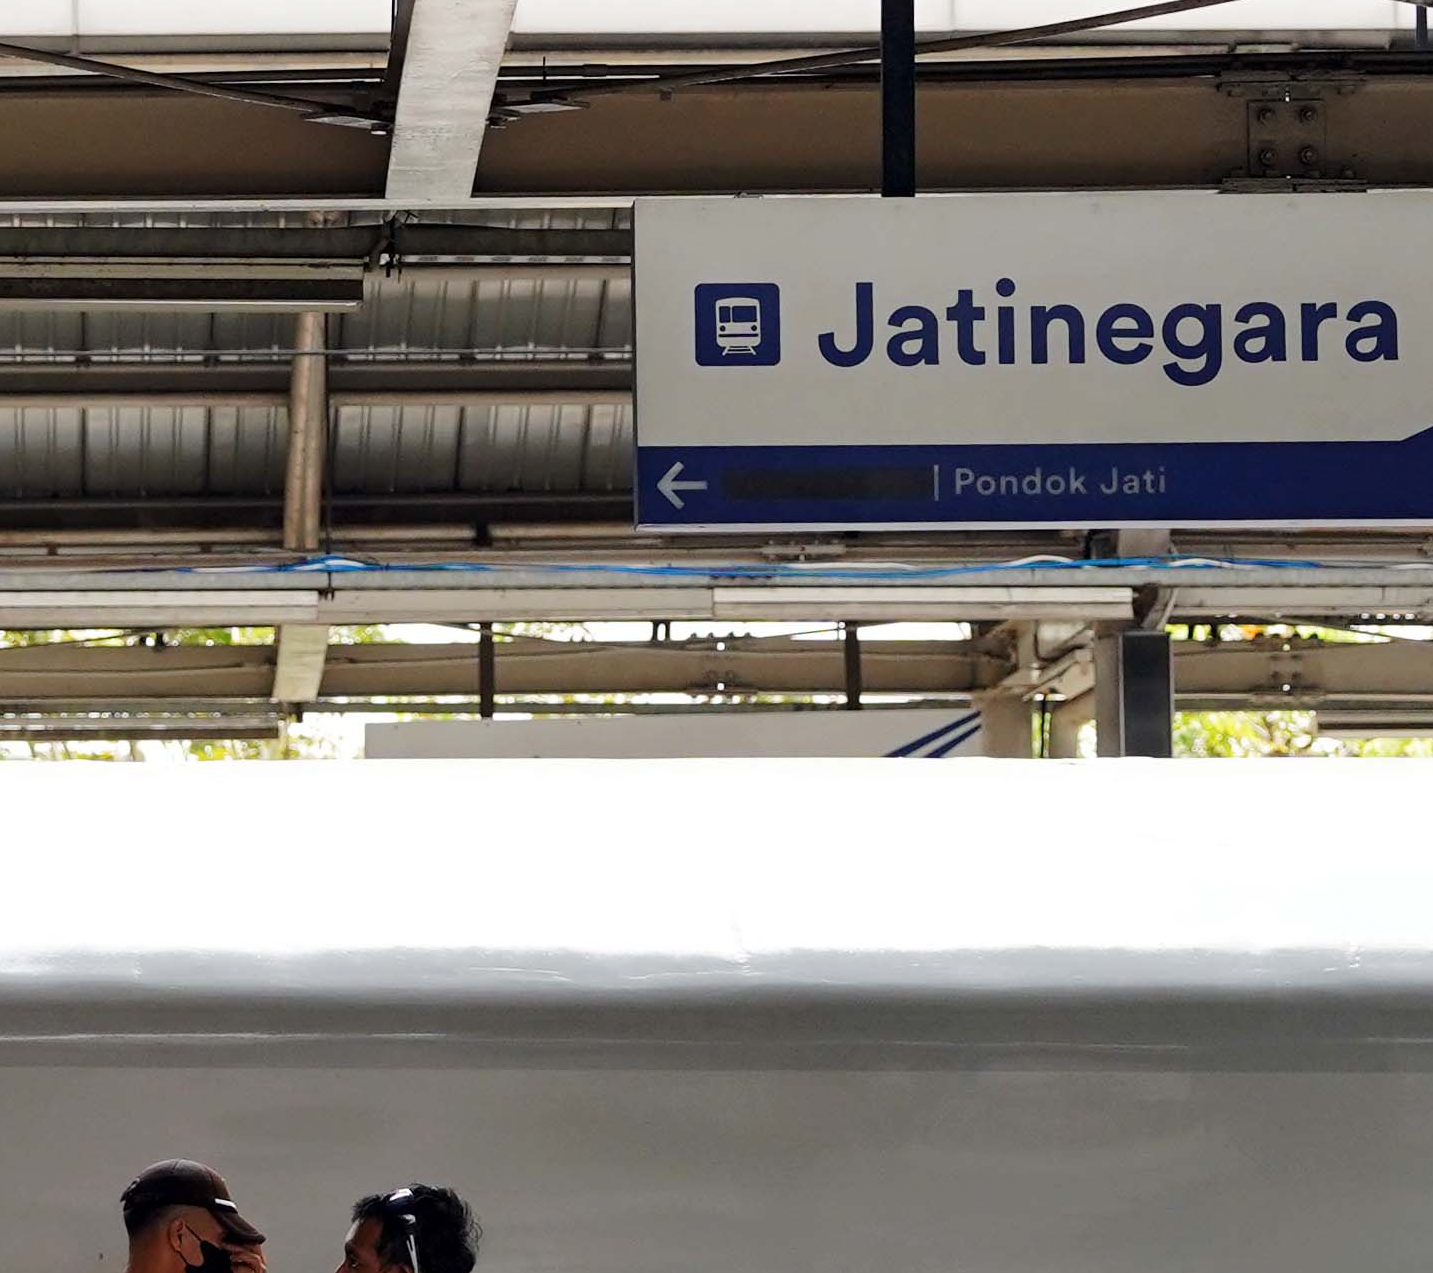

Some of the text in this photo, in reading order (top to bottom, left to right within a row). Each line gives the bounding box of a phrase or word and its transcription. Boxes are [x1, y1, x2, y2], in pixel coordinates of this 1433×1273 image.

[818, 277, 1399, 386] Jatinegara
[954, 466, 1166, 496] Pondok Jati
